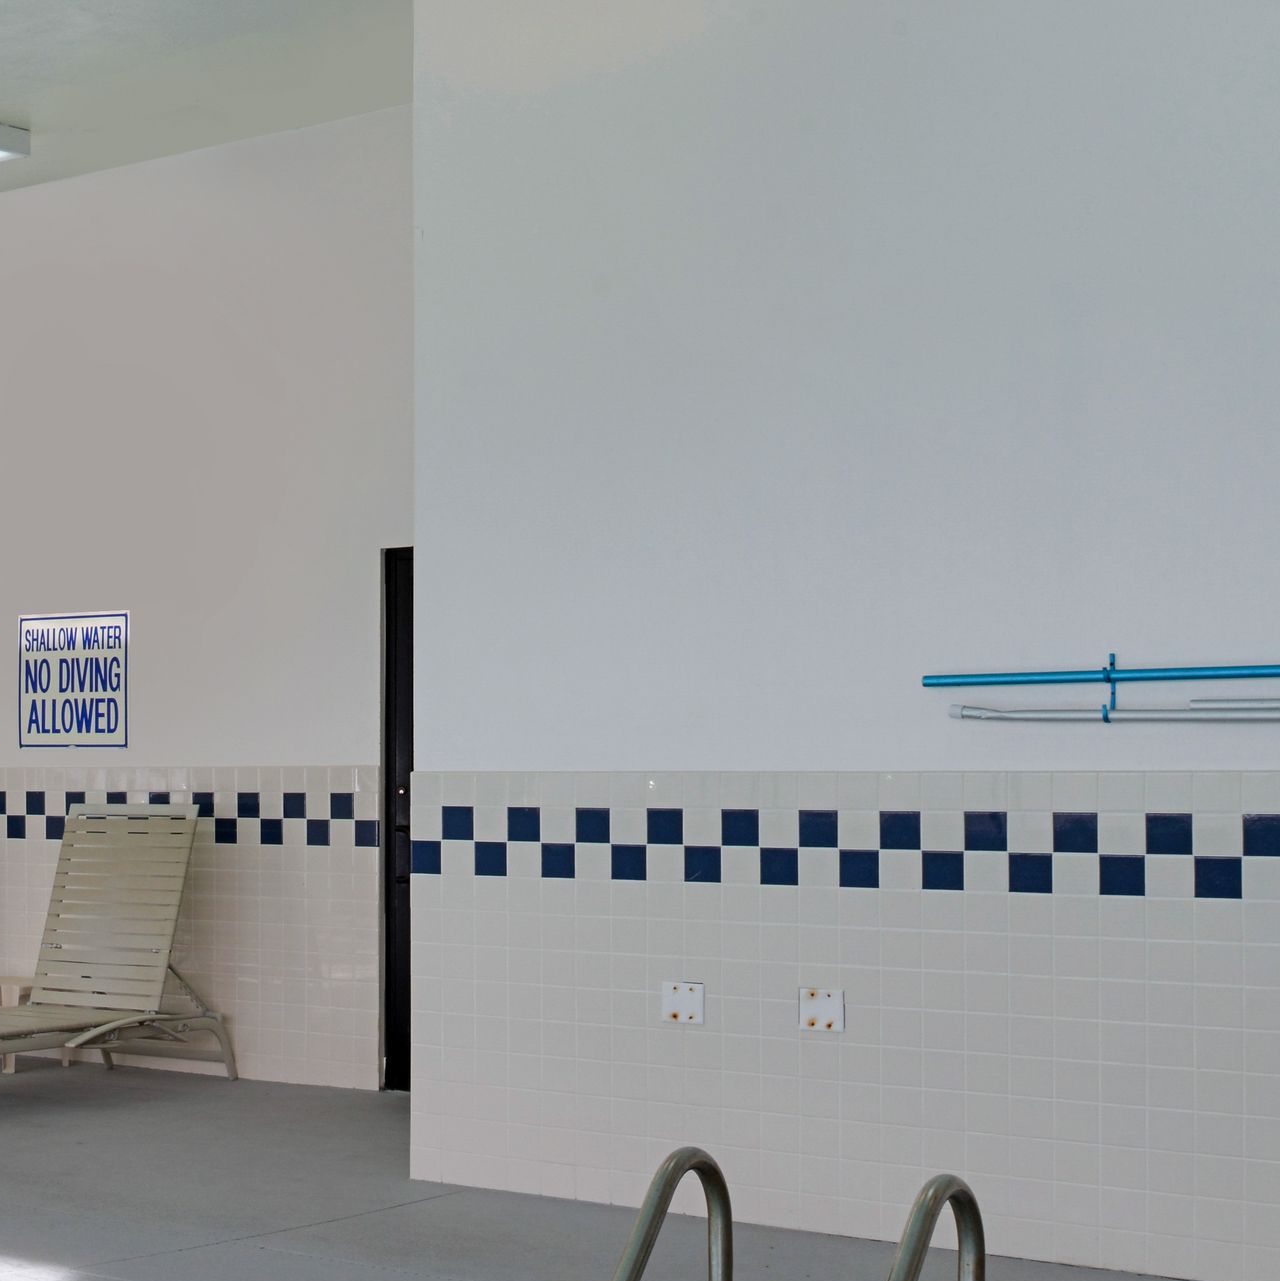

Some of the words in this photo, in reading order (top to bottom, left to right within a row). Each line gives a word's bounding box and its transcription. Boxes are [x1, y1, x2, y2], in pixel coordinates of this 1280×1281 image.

[25, 627, 78, 652] SHALLOW
[81, 625, 122, 650] WATER
[25, 658, 51, 694] NO
[58, 656, 121, 693] DIVING
[27, 698, 119, 734] ALLOWED
